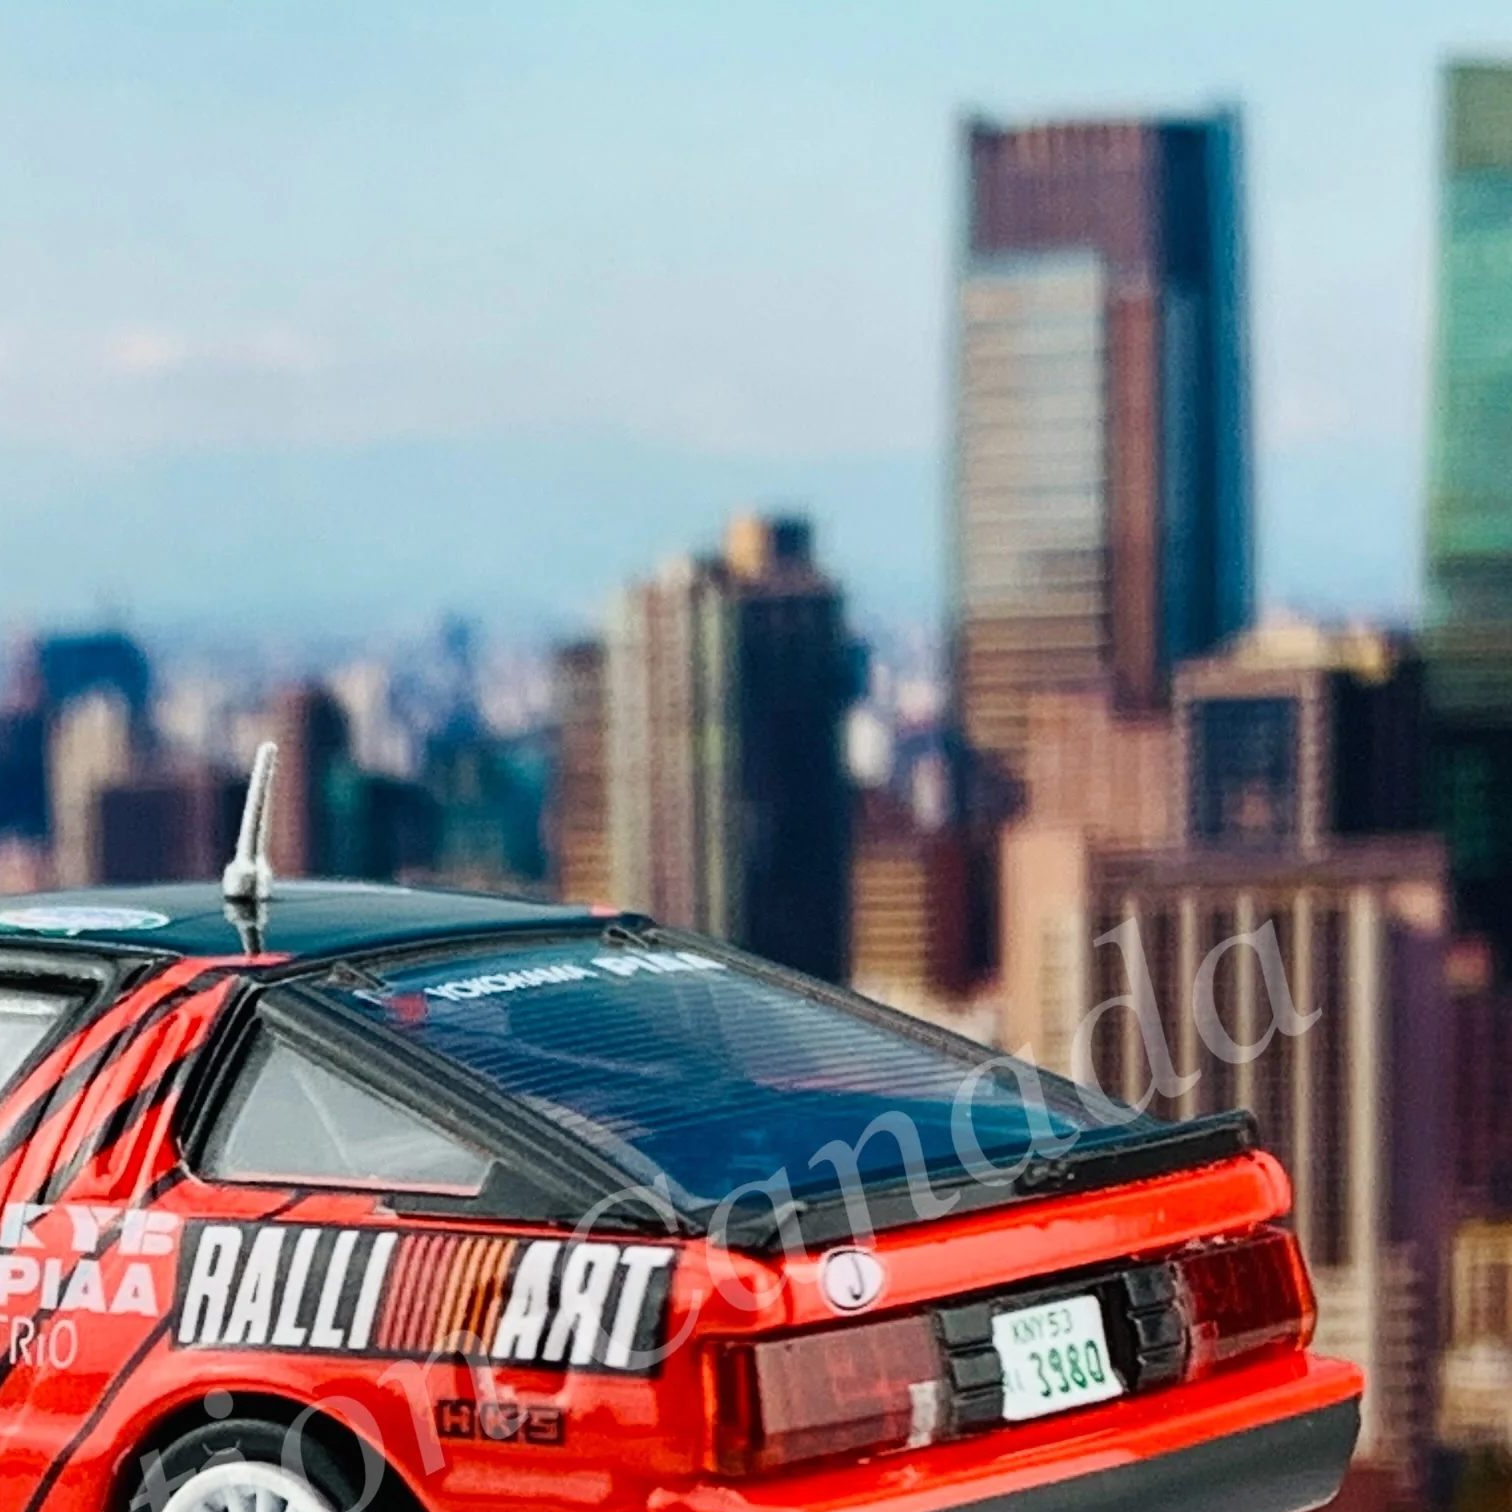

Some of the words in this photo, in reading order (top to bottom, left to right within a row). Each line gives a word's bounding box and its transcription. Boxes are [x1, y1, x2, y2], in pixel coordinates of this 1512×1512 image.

[178, 1224, 398, 1350] RALLI
[1029, 1339, 1106, 1398] 3980
[441, 1402, 563, 1442] HKS
